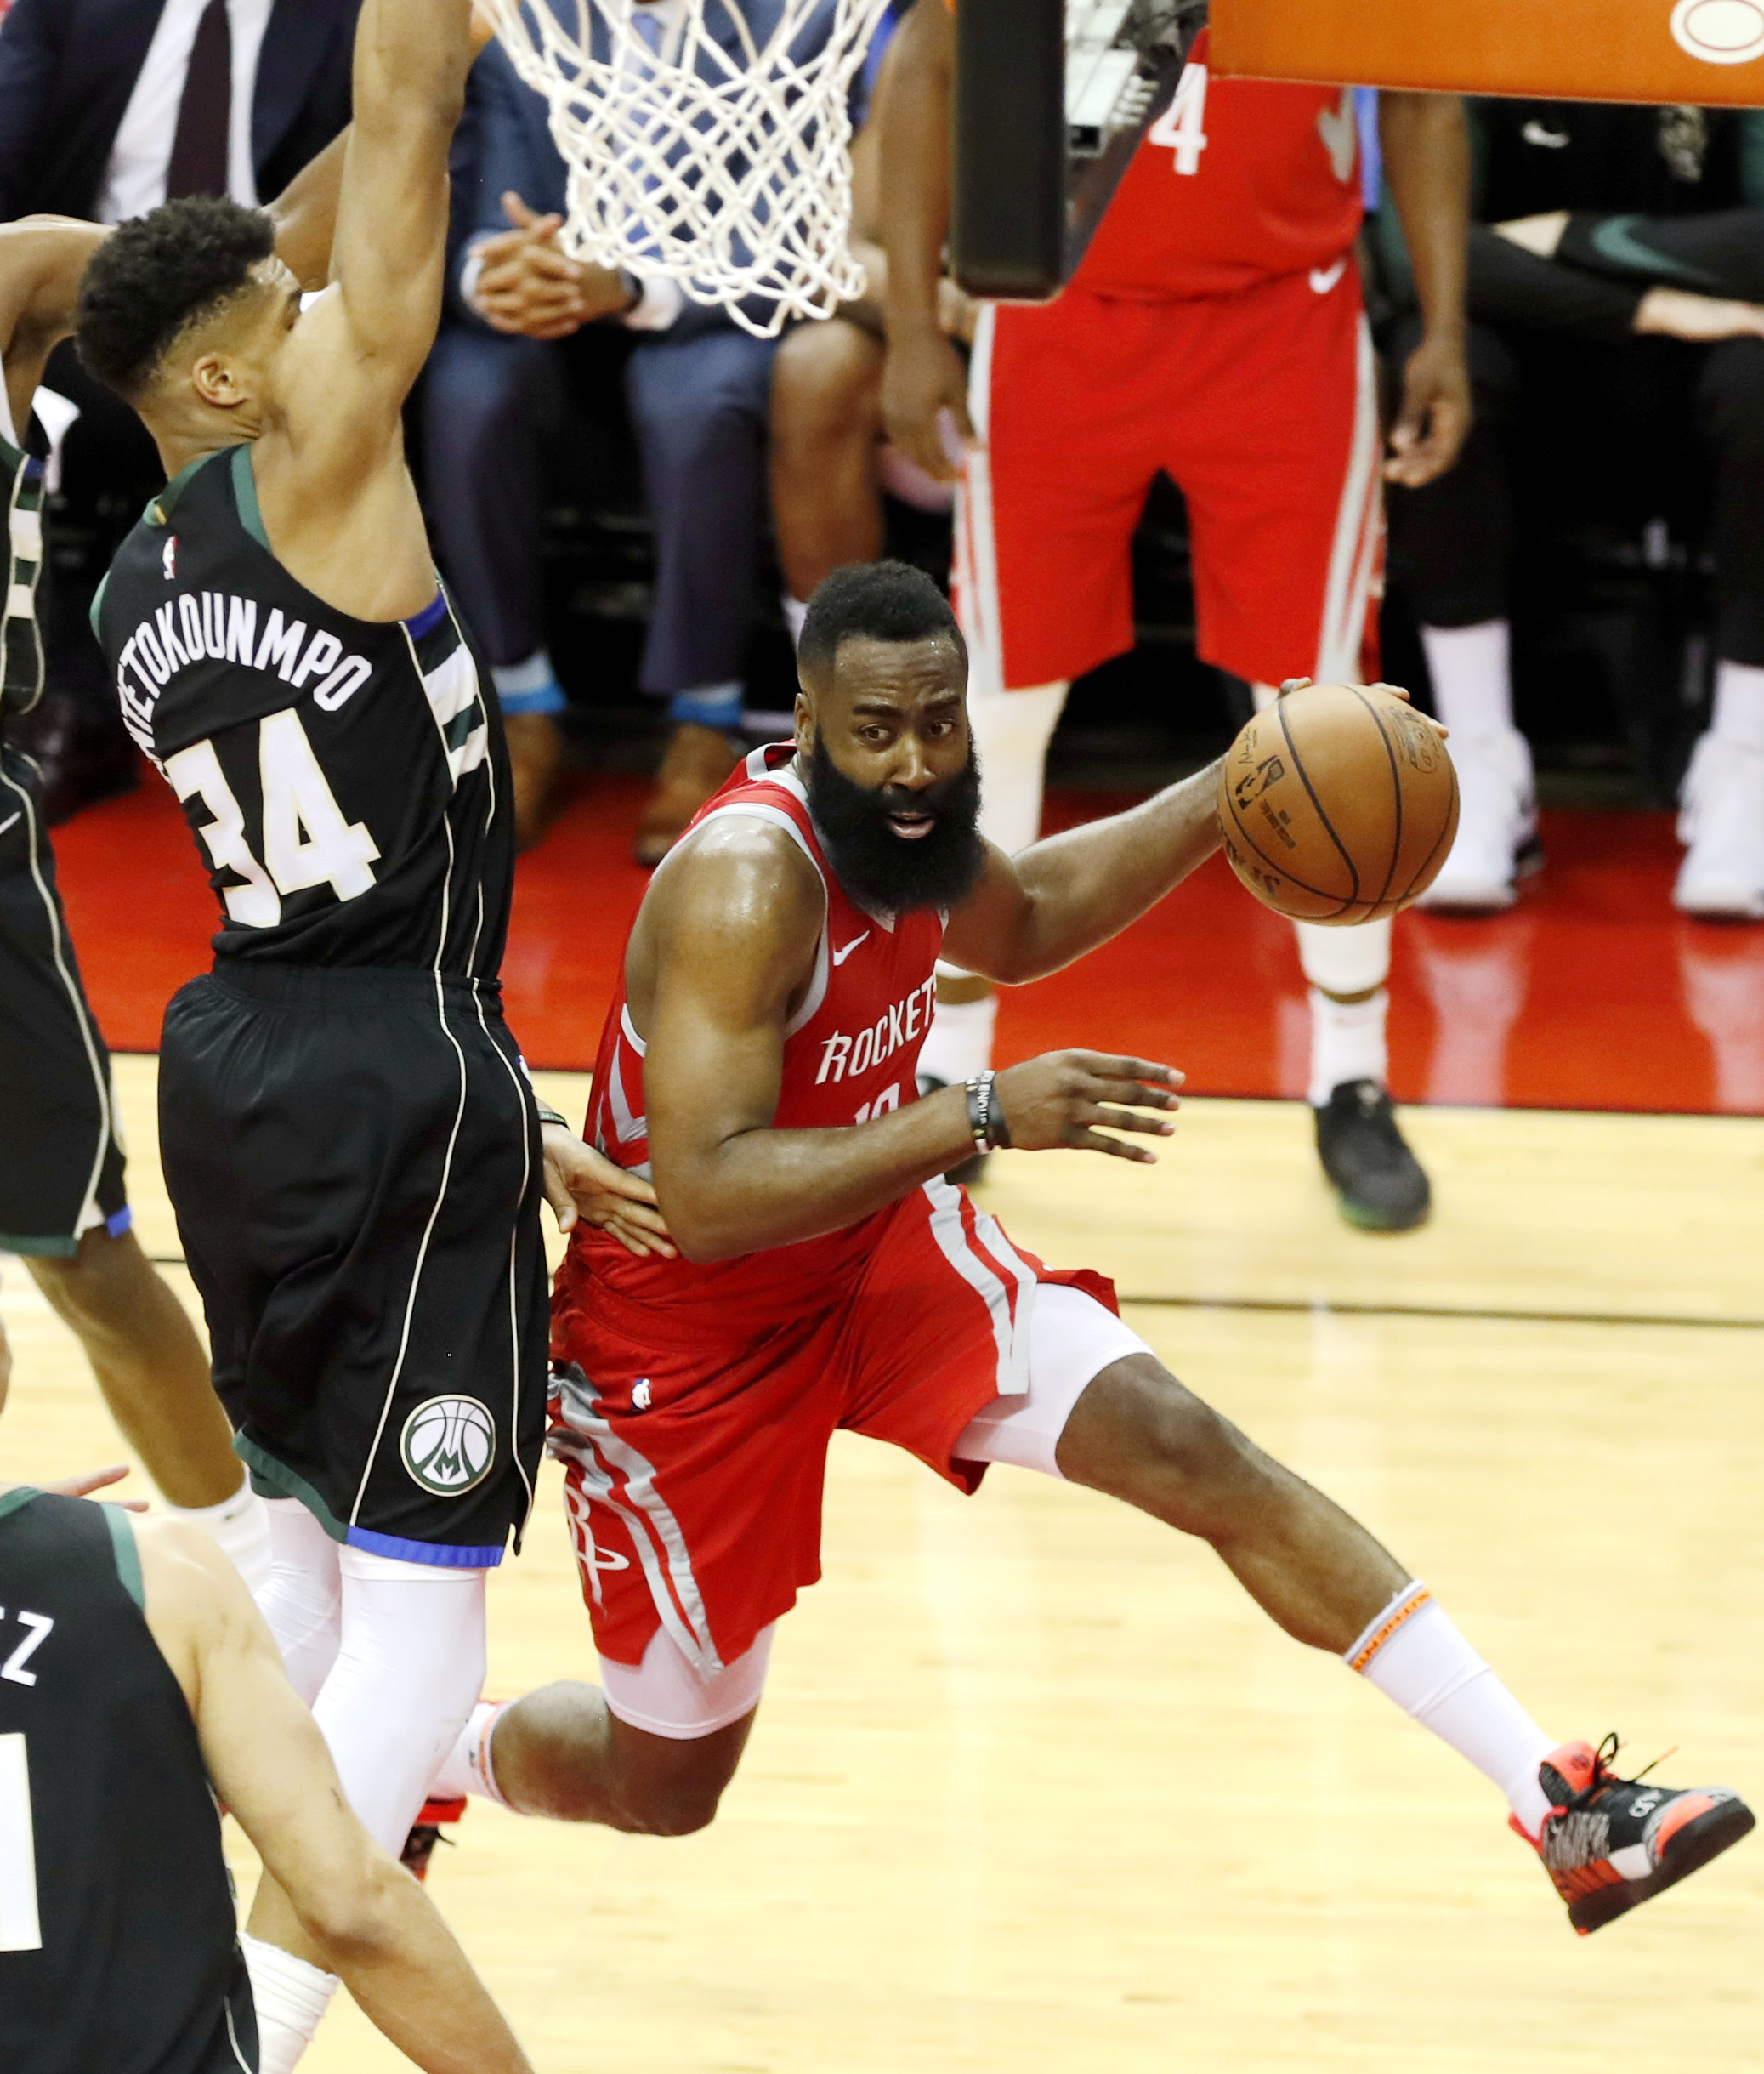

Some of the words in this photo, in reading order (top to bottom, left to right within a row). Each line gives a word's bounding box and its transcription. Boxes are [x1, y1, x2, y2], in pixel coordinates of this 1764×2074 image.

[117, 591, 372, 787] TETOKOUNMPO
[163, 707, 381, 929] 34
[815, 974, 936, 1085] ROCKET
[0, 1605, 54, 1687] Z
